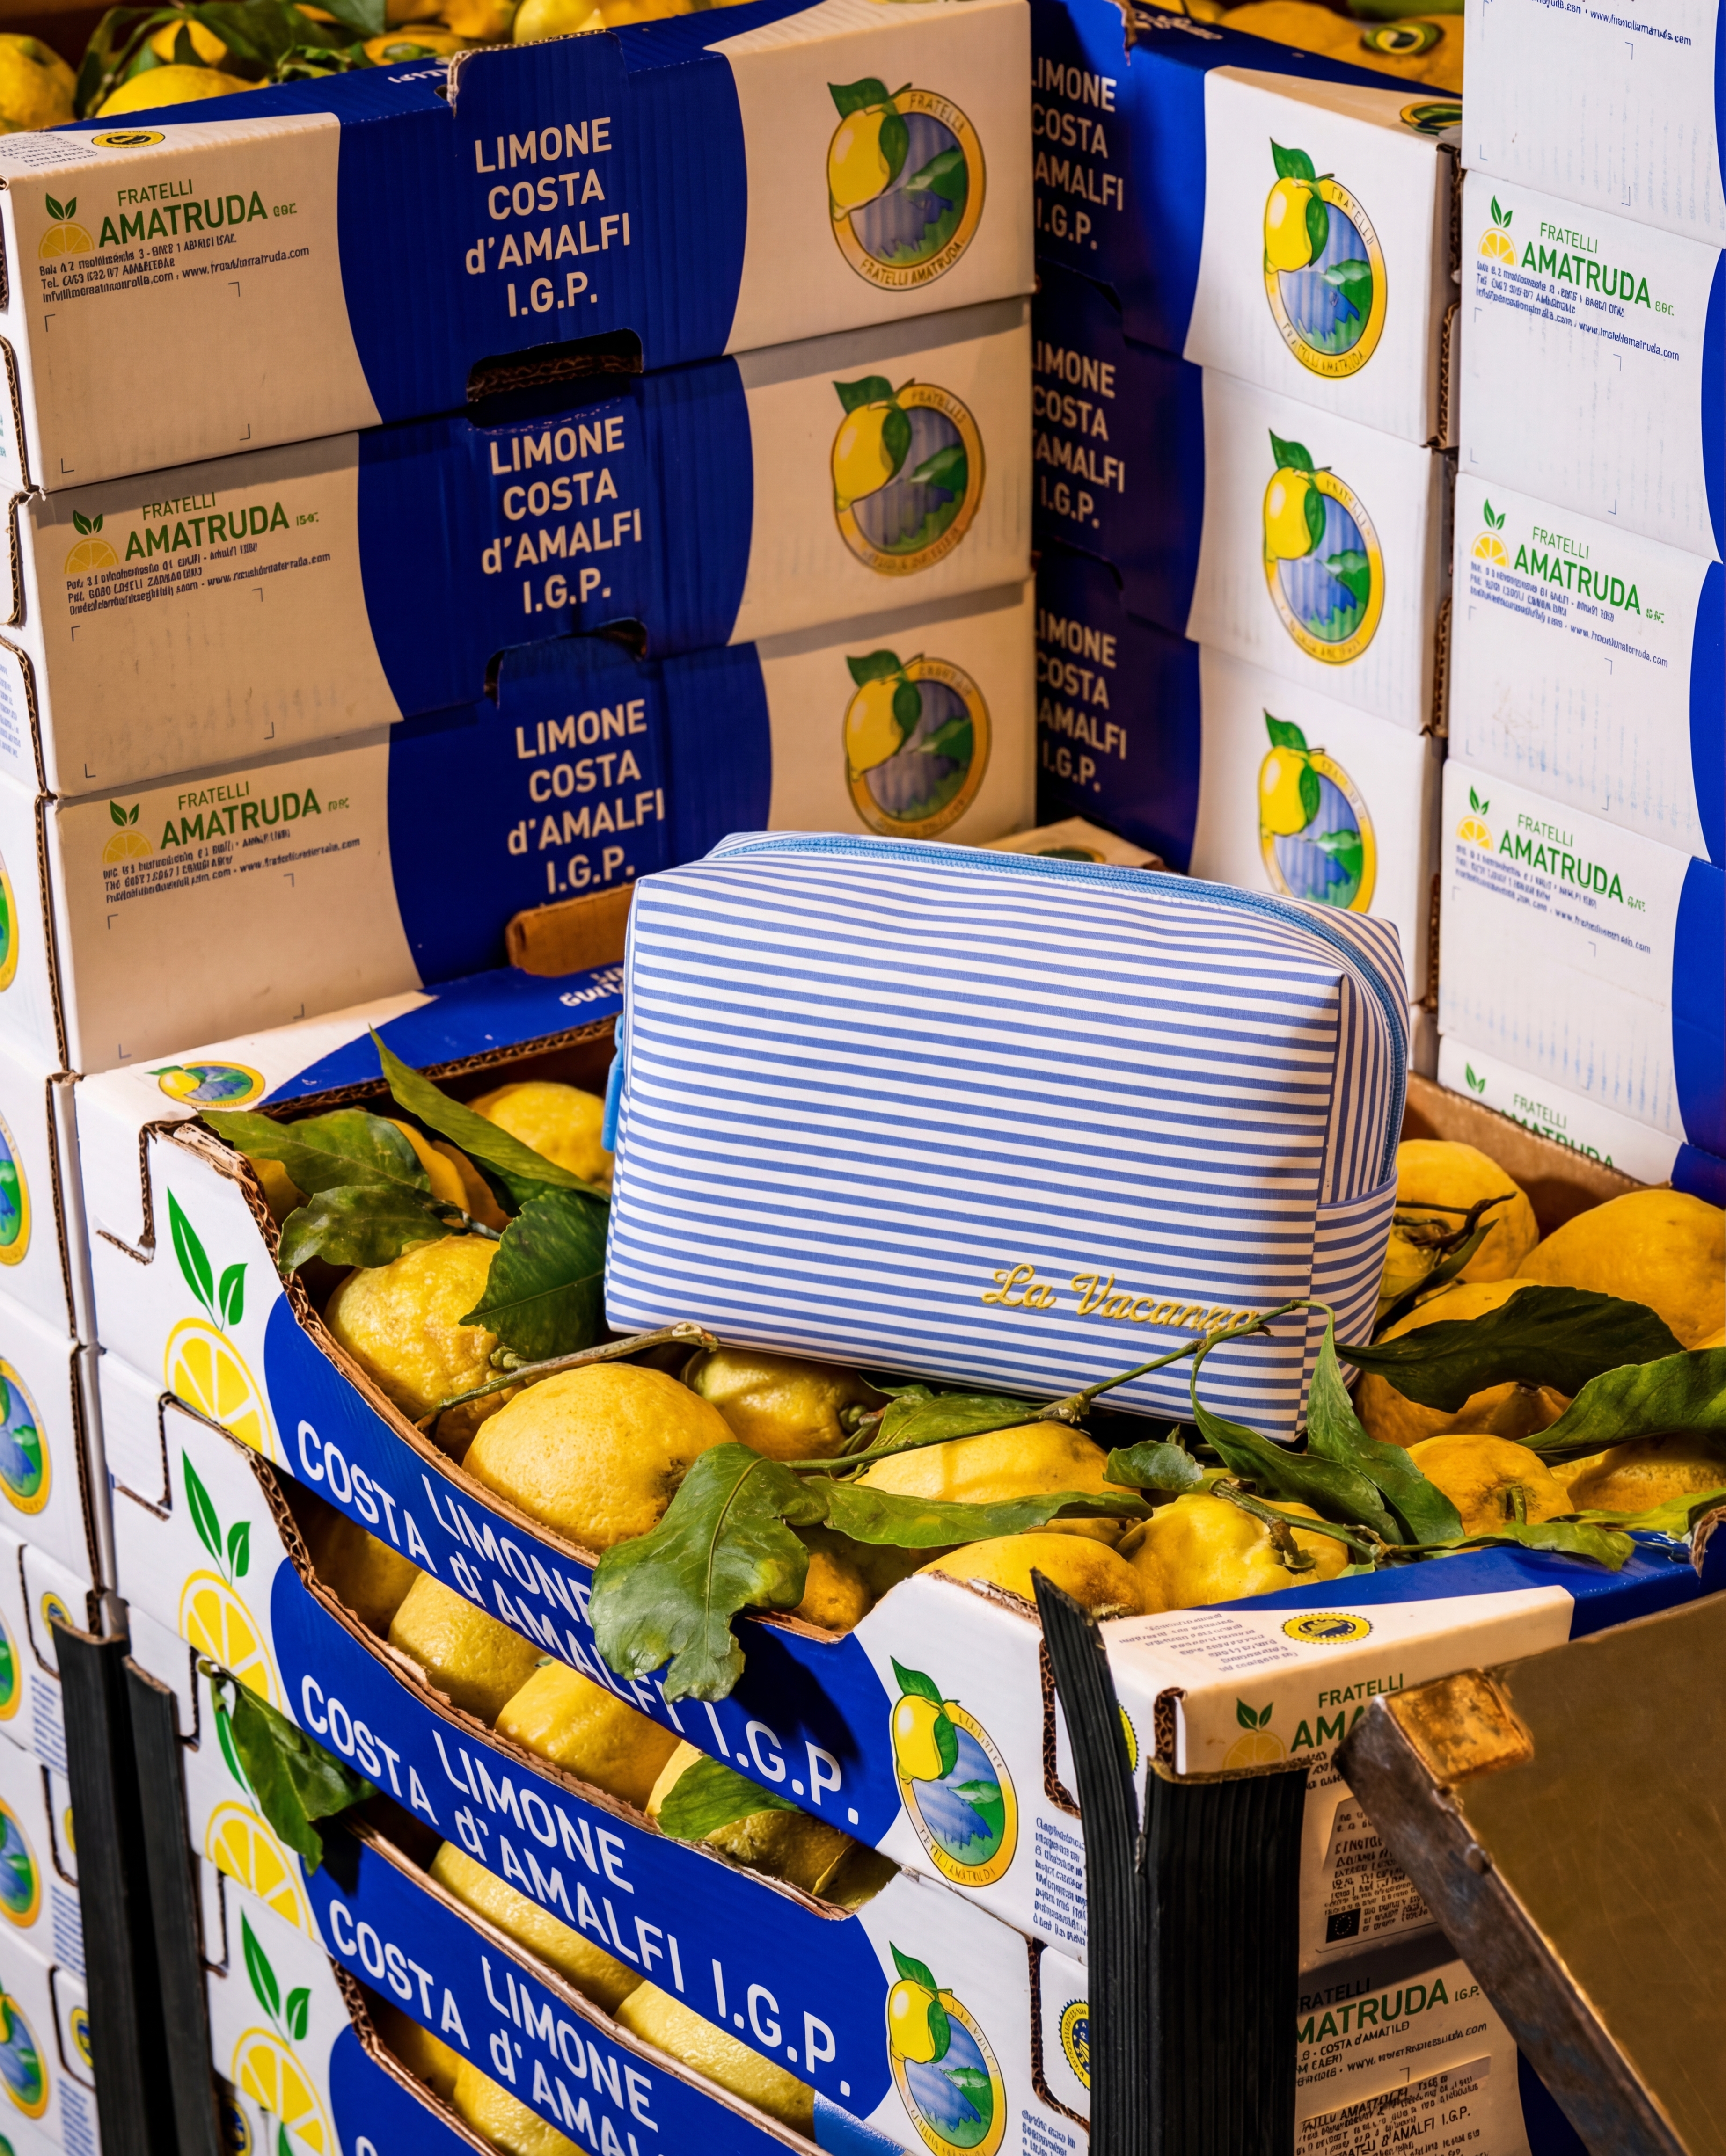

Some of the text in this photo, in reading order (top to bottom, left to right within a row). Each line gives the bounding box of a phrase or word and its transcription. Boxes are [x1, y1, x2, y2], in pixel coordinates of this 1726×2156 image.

[1031, 57, 1117, 113] IMONE
[475, 117, 612, 173] LIMONE
[1031, 103, 1108, 159] COSTA
[117, 179, 193, 206] FRATELLI
[488, 168, 605, 220] COSTA
[1034, 152, 1123, 211] AMALFI
[99, 191, 268, 248] AMATRUDA
[465, 212, 630, 275] d'AMALFI
[1037, 198, 1097, 251] I.G.P.
[1540, 222, 1597, 254] FRATELLI
[507, 272, 597, 317] I.G.P.
[1521, 241, 1651, 309] AMATRUDA
[1033, 340, 1115, 399] IMONE
[1033, 385, 1108, 441] COSTA
[490, 416, 624, 476] LIMONE
[142, 492, 216, 520] FRATELLI
[503, 468, 618, 520] COSTA
[1041, 476, 1099, 529] I.G.P.
[125, 502, 290, 561] AMATRUDA
[482, 508, 642, 575] d'AMALFI
[1533, 526, 1589, 560] FRATELLI
[523, 568, 611, 614] I.G.P.
[1514, 544, 1641, 615] AMATRUDA
[1035, 609, 1117, 668] IMONE
[1035, 652, 1109, 709] COSTA
[516, 699, 647, 759] LIMONE
[1039, 697, 1126, 759] AMALFI
[529, 749, 641, 802] COSTA
[1043, 741, 1100, 792] I.G.P.
[160, 788, 321, 850] AMATRUDA
[178, 781, 249, 810] FRATELLI
[507, 788, 665, 855] d'AMALFI
[1517, 813, 1574, 847] FRATELLI
[546, 846, 635, 894] I.G.P.
[1499, 830, 1624, 904] AMATRUDA
[1514, 1093, 1567, 1129] FRATELLI
[981, 1263, 1056, 1309] La
[297, 1420, 438, 1574] COSTA
[702, 1700, 859, 1826] I.G.P.
[1318, 1673, 1403, 1708] FRATELLI
[432, 1729, 634, 1894] LIMONE
[300, 1674, 850, 2097] COSTA d'AMALFI I.G.P.
[329, 1899, 470, 2050] COSTA
[1298, 1977, 1370, 2012] RATELLI
[1297, 1978, 1449, 2045] MATRUDA
[481, 1955, 658, 2133] LIMONE
